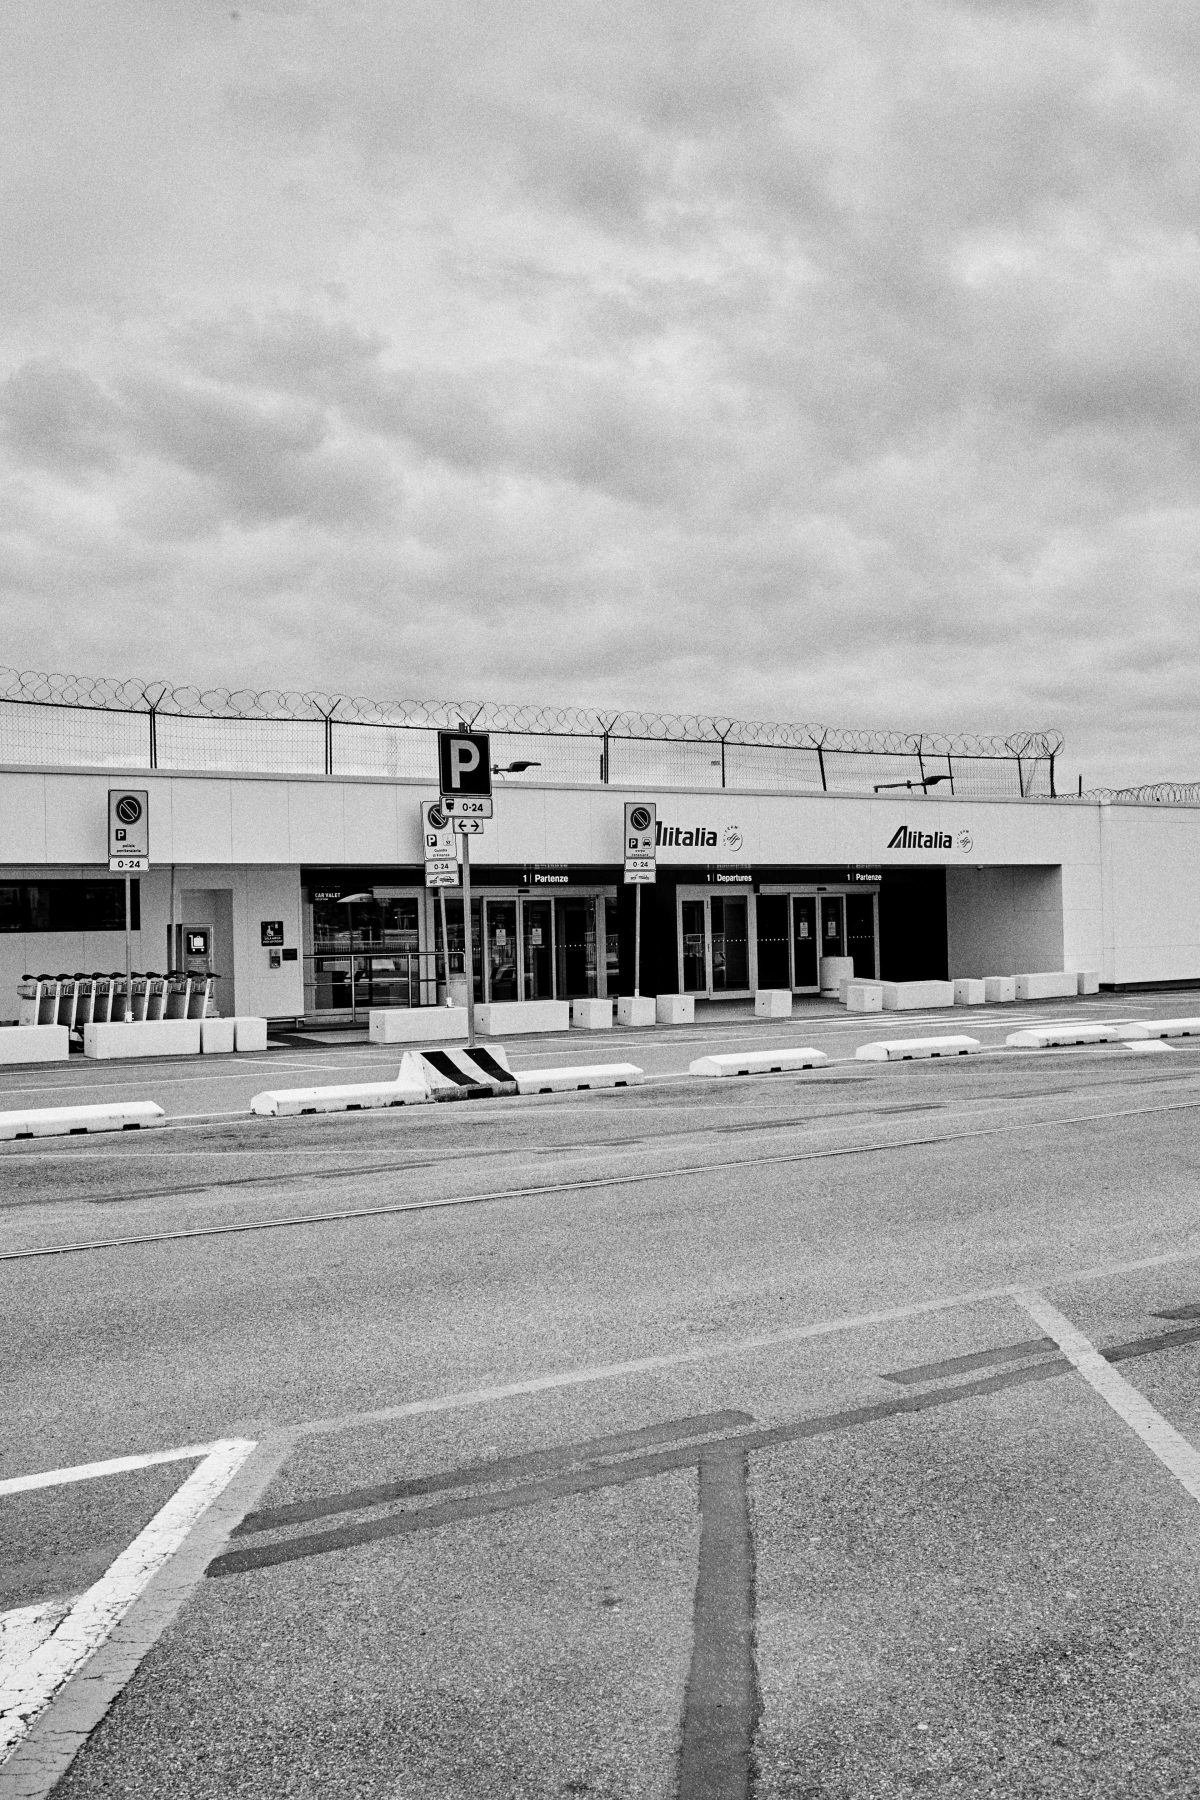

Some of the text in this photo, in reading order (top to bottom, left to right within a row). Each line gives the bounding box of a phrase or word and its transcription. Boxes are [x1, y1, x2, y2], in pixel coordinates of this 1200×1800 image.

[450, 739, 480, 788] P
[462, 803, 483, 812] 0-24
[887, 826, 952, 848] Alitalia
[534, 874, 569, 883] Partenze
[717, 874, 752, 883] Departures
[855, 873, 882, 881] Partenze
